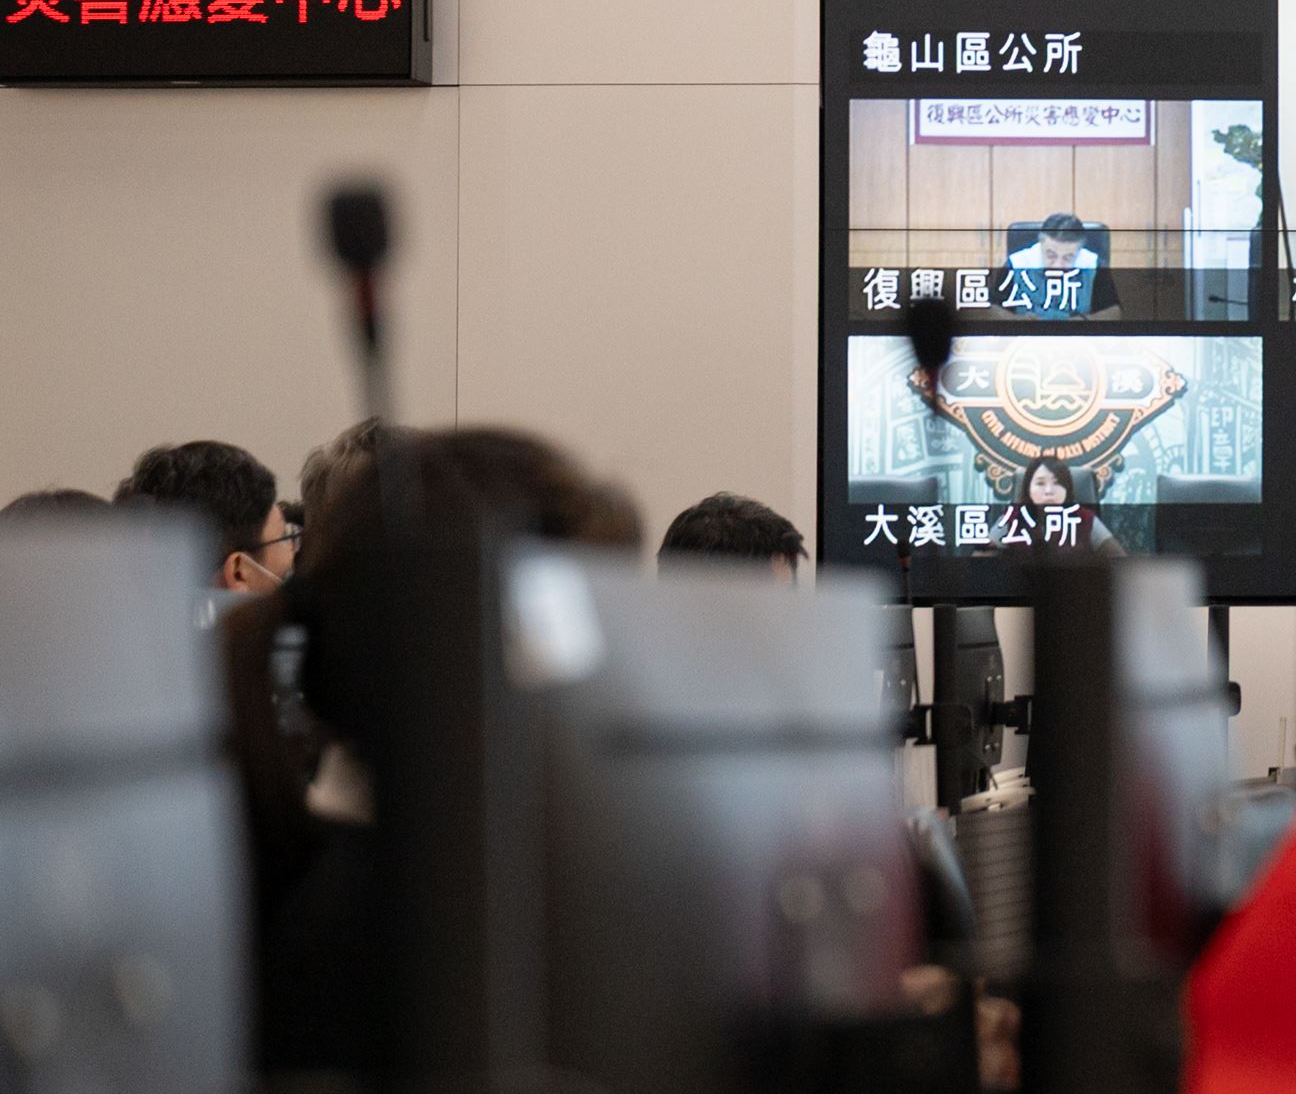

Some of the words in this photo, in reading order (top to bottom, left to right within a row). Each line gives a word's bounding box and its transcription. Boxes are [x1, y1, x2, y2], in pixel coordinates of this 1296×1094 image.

[863, 30, 1083, 74] 龜山區公所
[863, 267, 1082, 311] 復興區公所
[863, 503, 1082, 547] 大溪區公所
